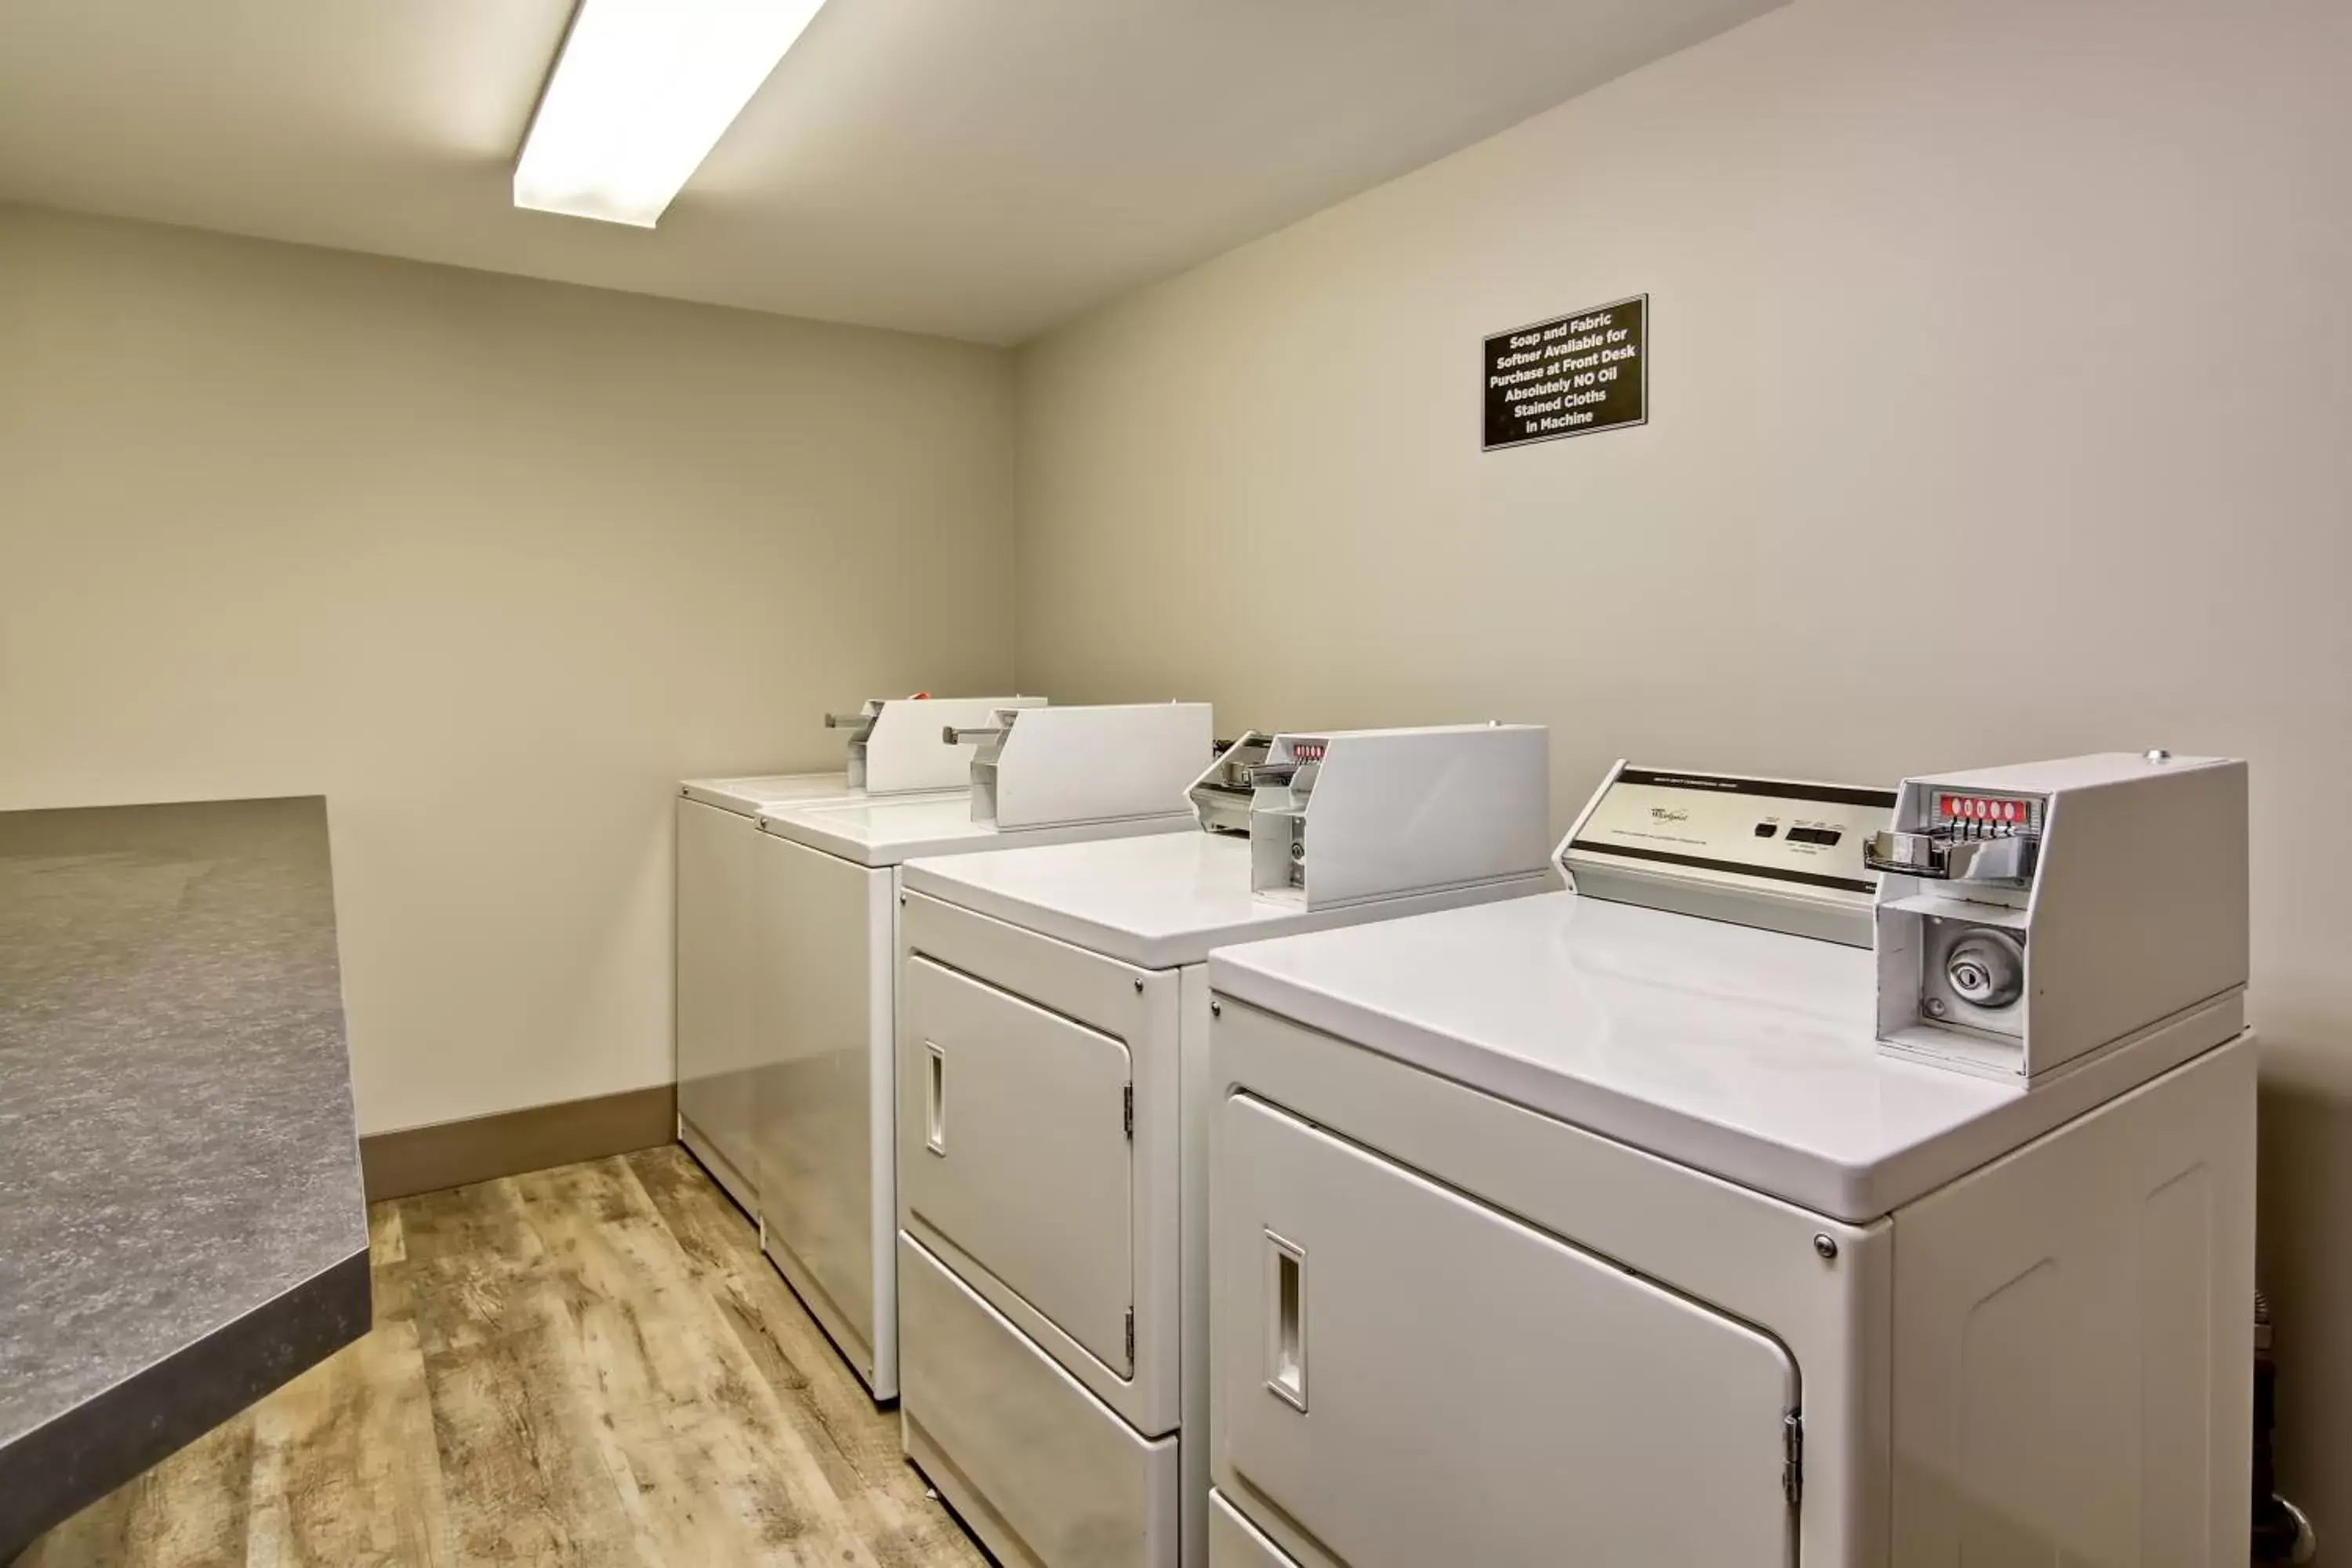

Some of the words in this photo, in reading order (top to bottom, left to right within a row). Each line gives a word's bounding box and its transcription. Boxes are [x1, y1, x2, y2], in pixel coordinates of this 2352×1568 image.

[1497, 352, 1542, 369] Softner
[1544, 335, 1603, 358] Available
[1606, 328, 1628, 343] for
[1509, 334, 1541, 349] Soap
[1543, 325, 1567, 340] and
[1570, 314, 1612, 333] Fabric
[1490, 369, 1544, 389] Purchase
[1547, 364, 1560, 376] at
[1563, 357, 1599, 372] Front
[1602, 345, 1637, 363] Desk
[1504, 379, 1570, 402] Absolutely
[1573, 374, 1595, 387] NO
[1598, 367, 1617, 382] Oil
[1514, 399, 1561, 418] Stained
[1564, 390, 1606, 407] Cloths
[1526, 420, 1537, 434] in
[1541, 411, 1593, 430] Machine
